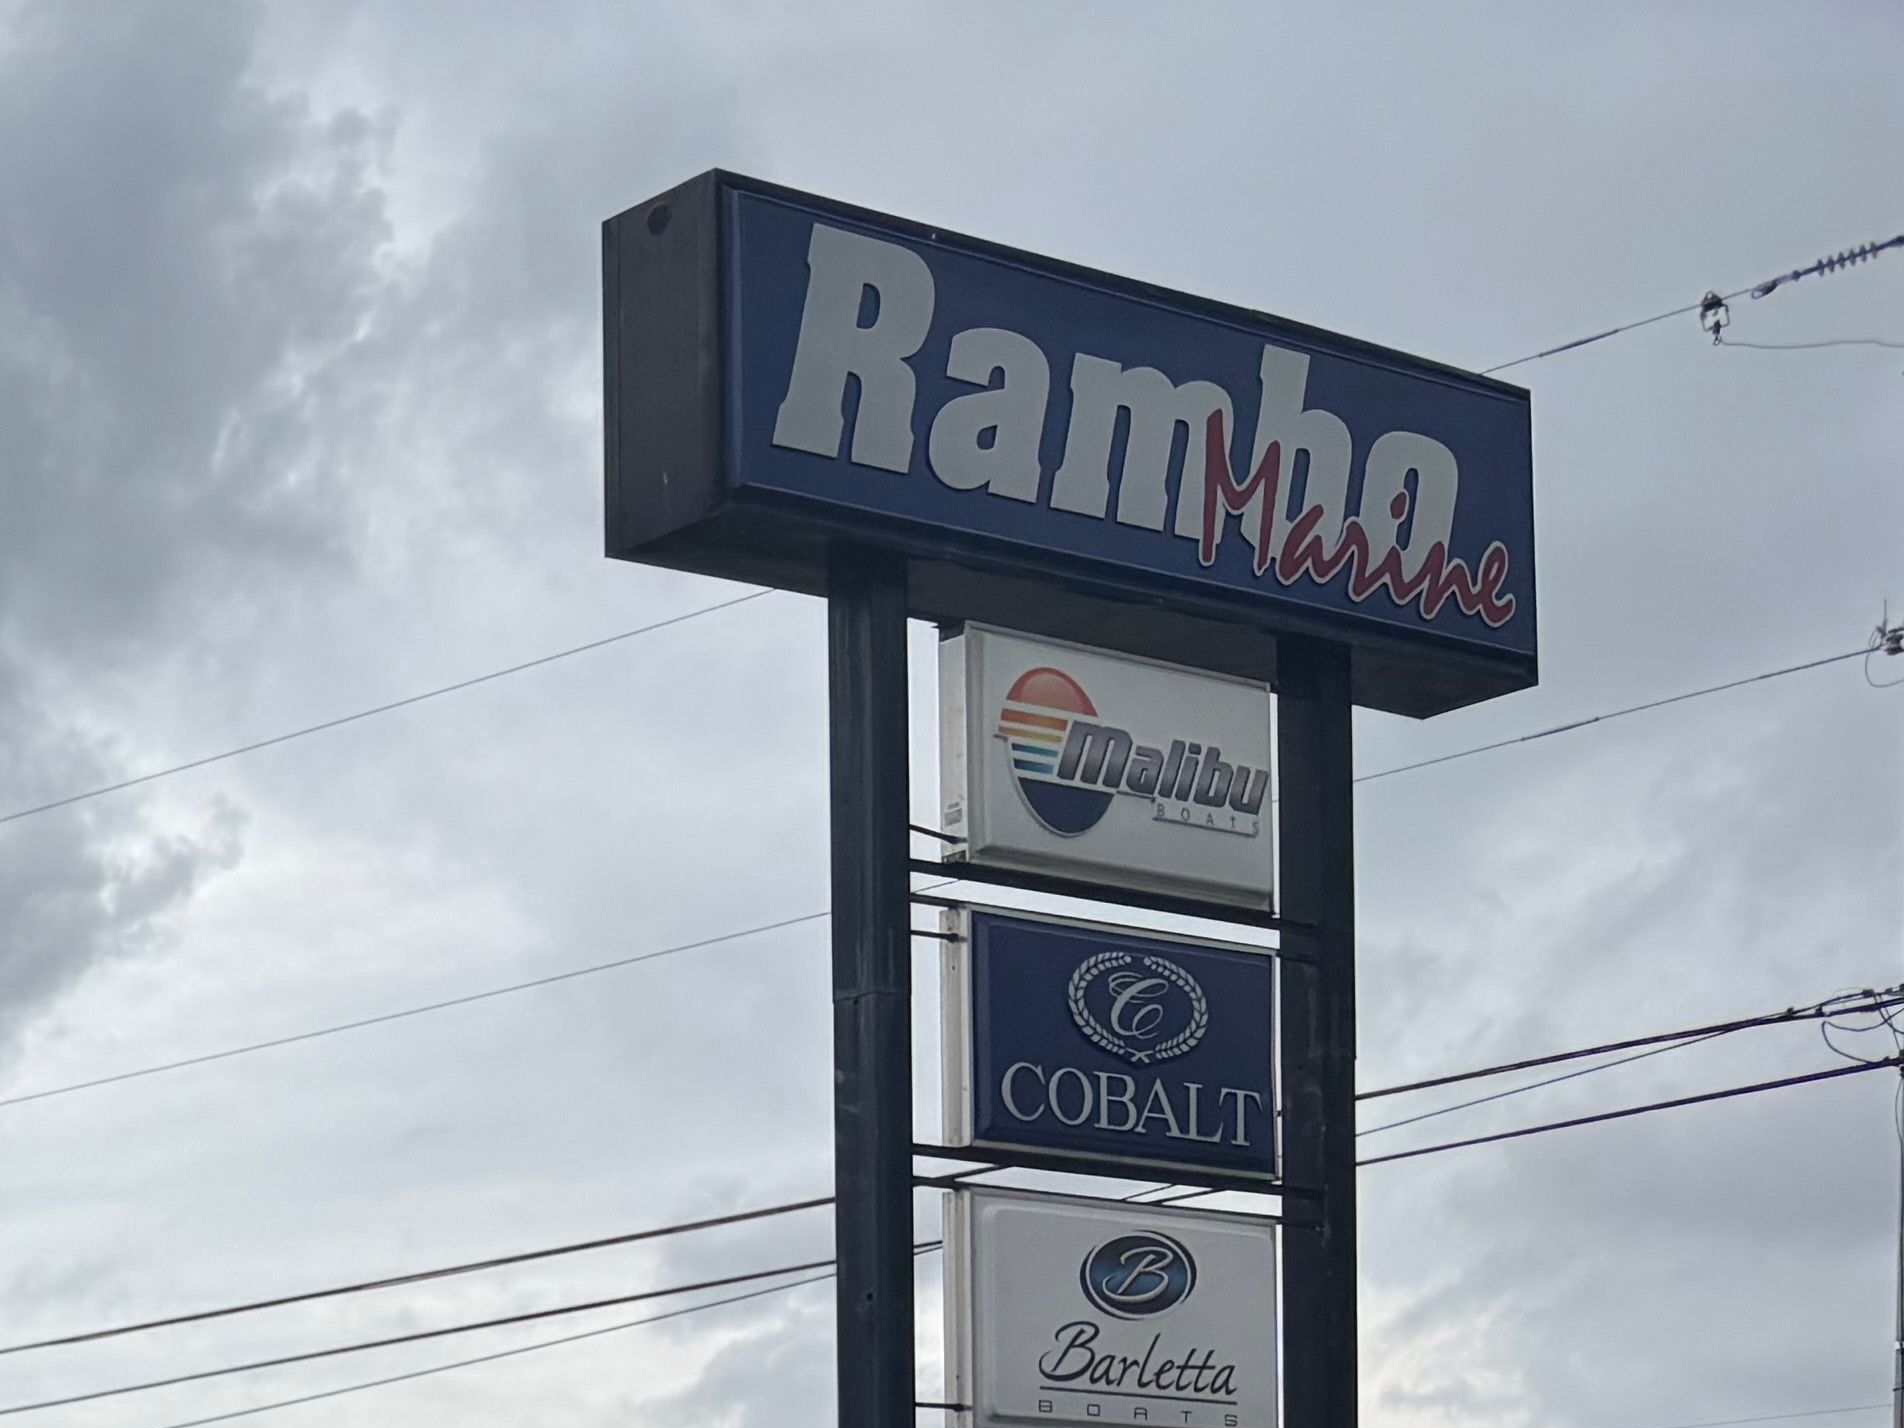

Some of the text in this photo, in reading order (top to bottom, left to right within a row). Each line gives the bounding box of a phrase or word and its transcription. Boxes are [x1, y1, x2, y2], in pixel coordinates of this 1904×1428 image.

[771, 222, 1459, 575] Rambo
[1198, 407, 1516, 628] Marine
[1056, 720, 1270, 816] Malibu
[1156, 803, 1260, 837] BOATS
[1001, 1061, 1263, 1147] COBALT
[1038, 1321, 1237, 1396] Barletta
[1038, 1400, 1238, 1427] BOATS
